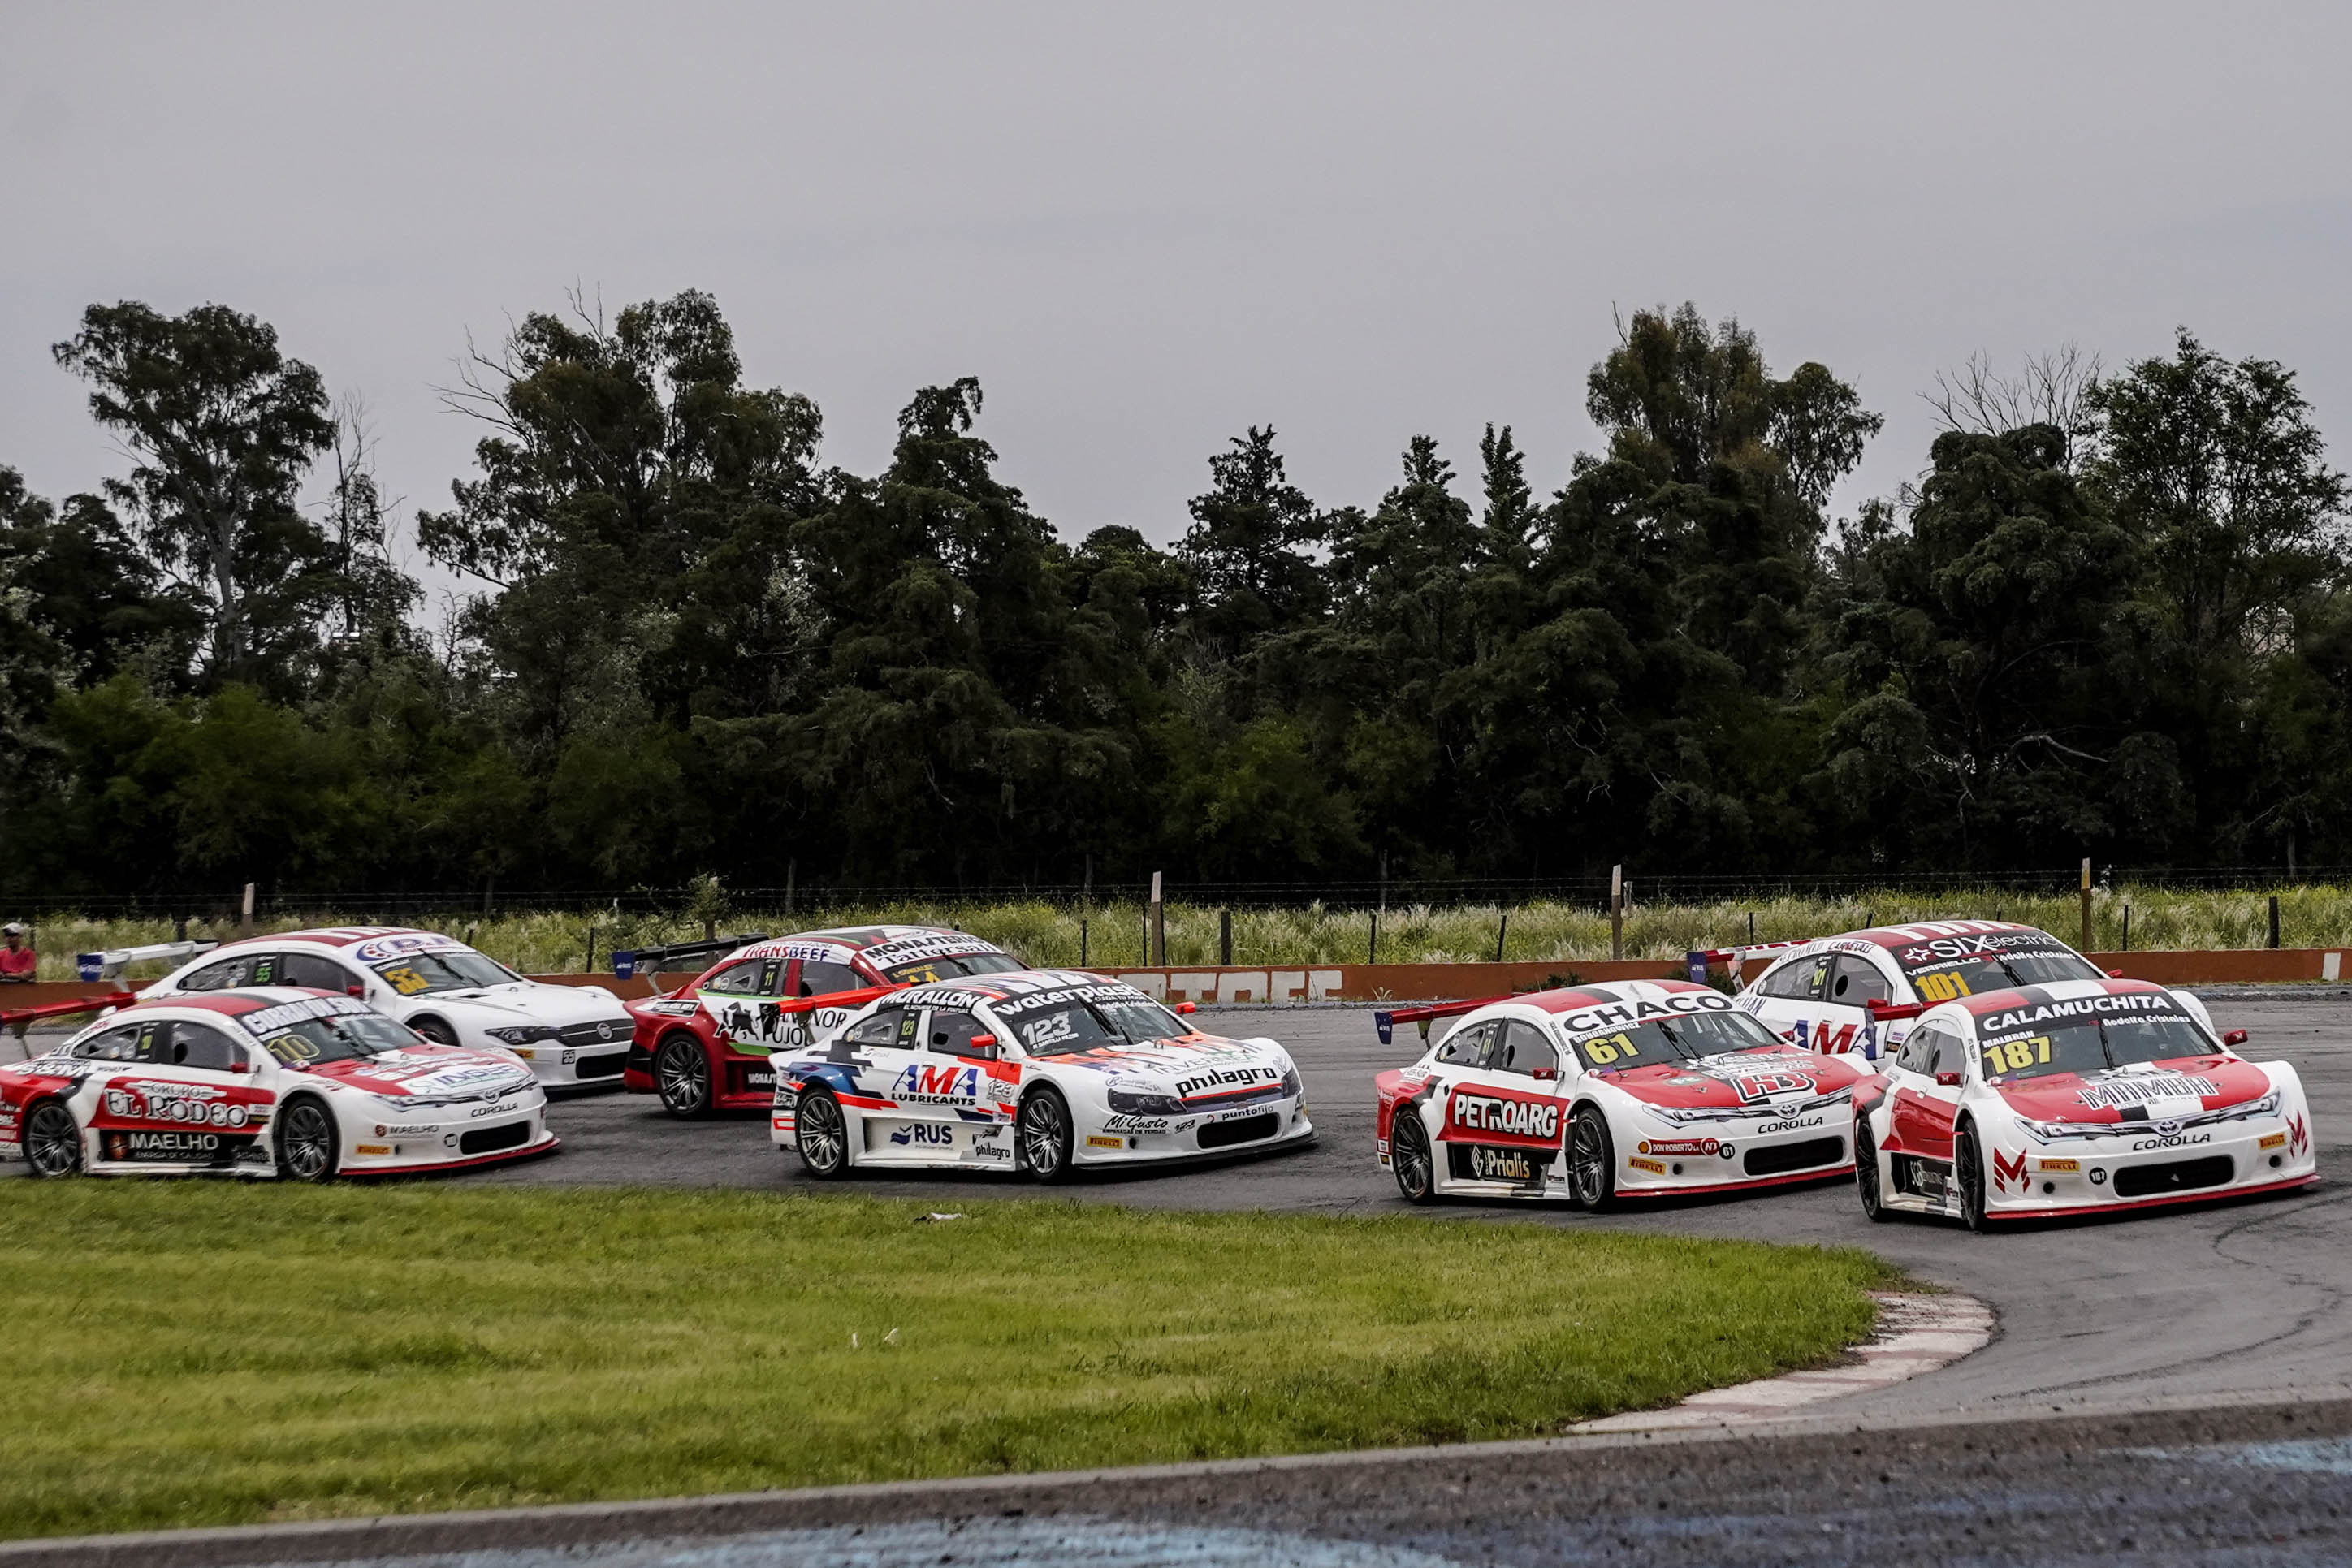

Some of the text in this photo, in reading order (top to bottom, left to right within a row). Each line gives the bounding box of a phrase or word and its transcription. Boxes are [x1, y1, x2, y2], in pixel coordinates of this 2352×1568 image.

[742, 944, 830, 961] TRANSBEEF
[878, 944, 997, 965] Tattersall
[1905, 957, 1982, 977] VERRIELLO
[1914, 971, 1972, 1003] 101
[992, 983, 1144, 1015] waterplast
[1564, 996, 1733, 1032] CHACO
[1982, 996, 2172, 1032] CALAMUCHITA
[901, 1019, 915, 1036] 123
[1021, 1010, 1071, 1046] 123
[266, 1034, 320, 1062] 10
[1585, 1033, 1639, 1065] 61
[1982, 1035, 2051, 1074] 187
[748, 1073, 777, 1084] MONAST
[892, 1065, 979, 1096] AMA
[1176, 1067, 1278, 1098] philagro
[988, 1080, 1014, 1097] 123
[105, 1088, 249, 1128] EL RODEO
[891, 1093, 976, 1106] LUBRICANTS
[471, 1102, 518, 1117] COROLLA
[1454, 1093, 1558, 1138] PETROARG
[389, 1125, 439, 1134] MAELHO
[1105, 1115, 1168, 1131] Mi Gusto
[1174, 1119, 1195, 1132] 123
[1757, 1117, 1823, 1134] COROLLA
[129, 1133, 219, 1151] MAELHO
[914, 1124, 953, 1144] RUS
[1089, 1137, 1121, 1147] PIRELLI
[2132, 1133, 2211, 1151] COROLLA
[975, 1141, 1010, 1160] philagro
[1652, 1143, 1665, 1152] DON
[1665, 1143, 1693, 1151] ROBERTO
[1723, 1146, 1734, 1157] 61
[1487, 1149, 1531, 1179] Prialis
[1631, 1159, 1664, 1173] PIRELLI
[2041, 1160, 2077, 1171] PIRELLI
[2090, 1171, 2105, 1181] 187
